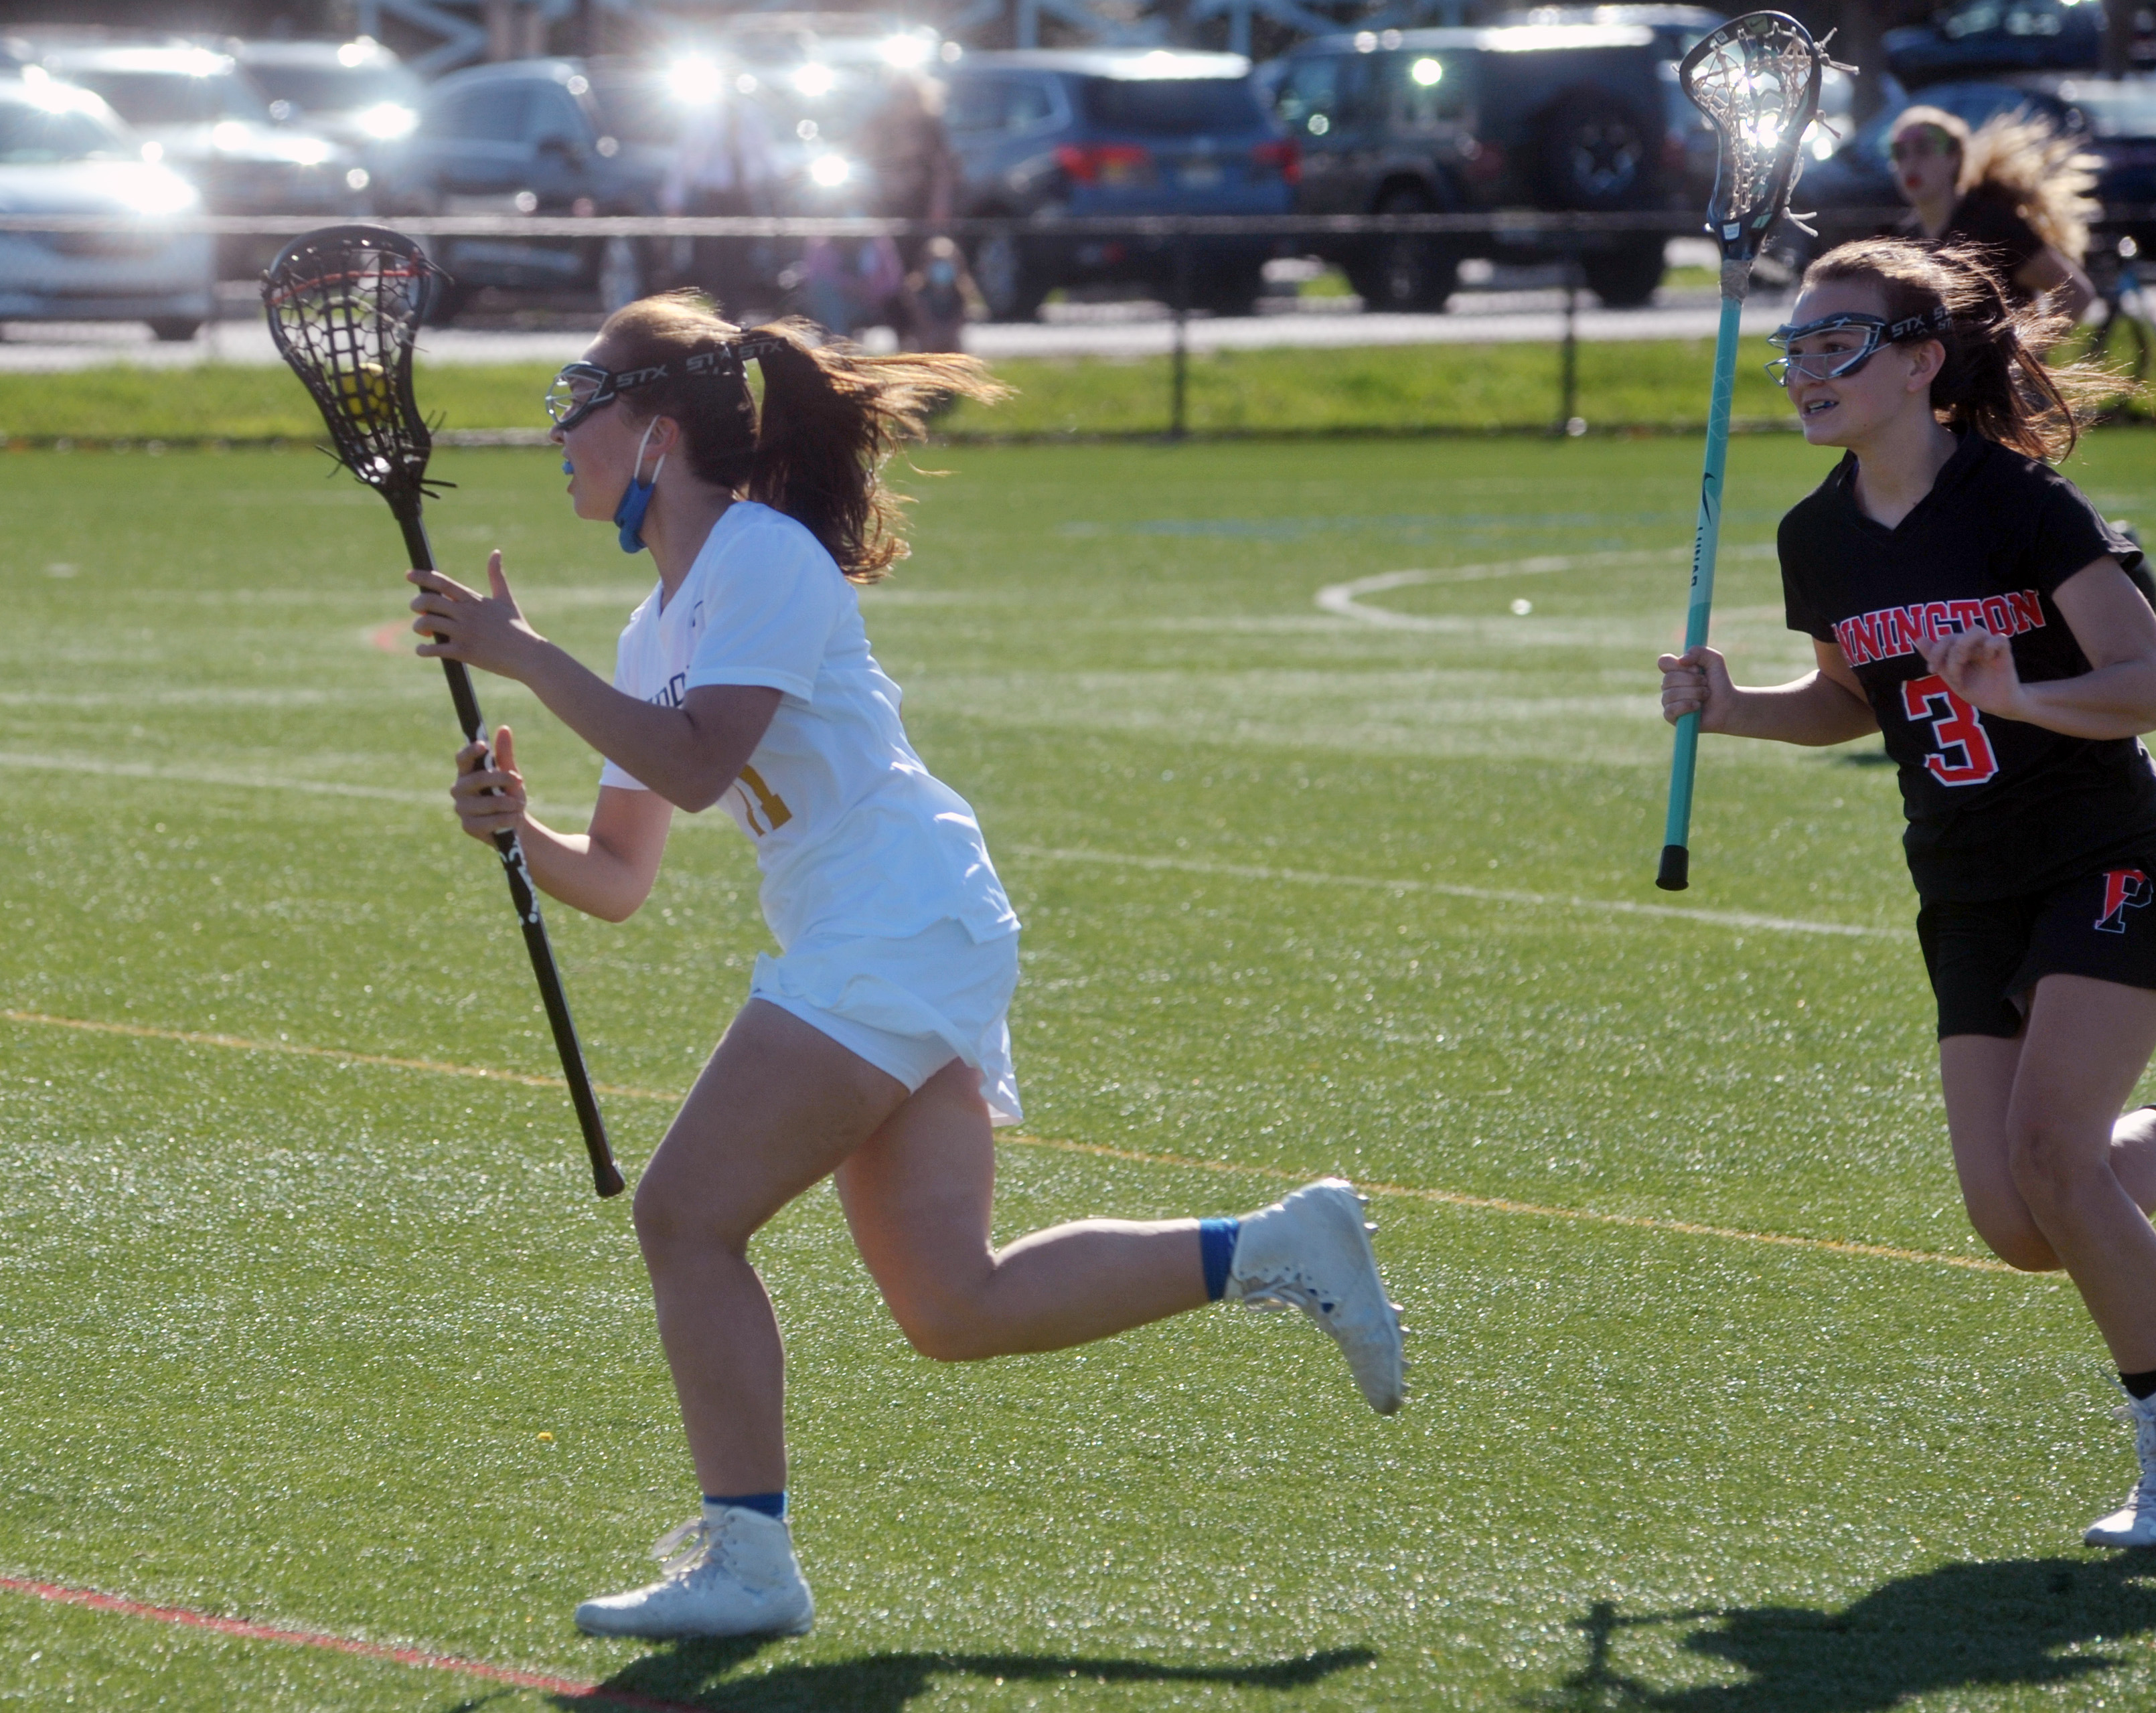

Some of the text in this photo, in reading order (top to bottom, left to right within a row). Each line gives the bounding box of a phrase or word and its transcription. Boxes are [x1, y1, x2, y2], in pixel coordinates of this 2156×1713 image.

[615, 364, 668, 388] STX
[1902, 674, 1999, 787] 3
[2094, 869, 2154, 934] P
